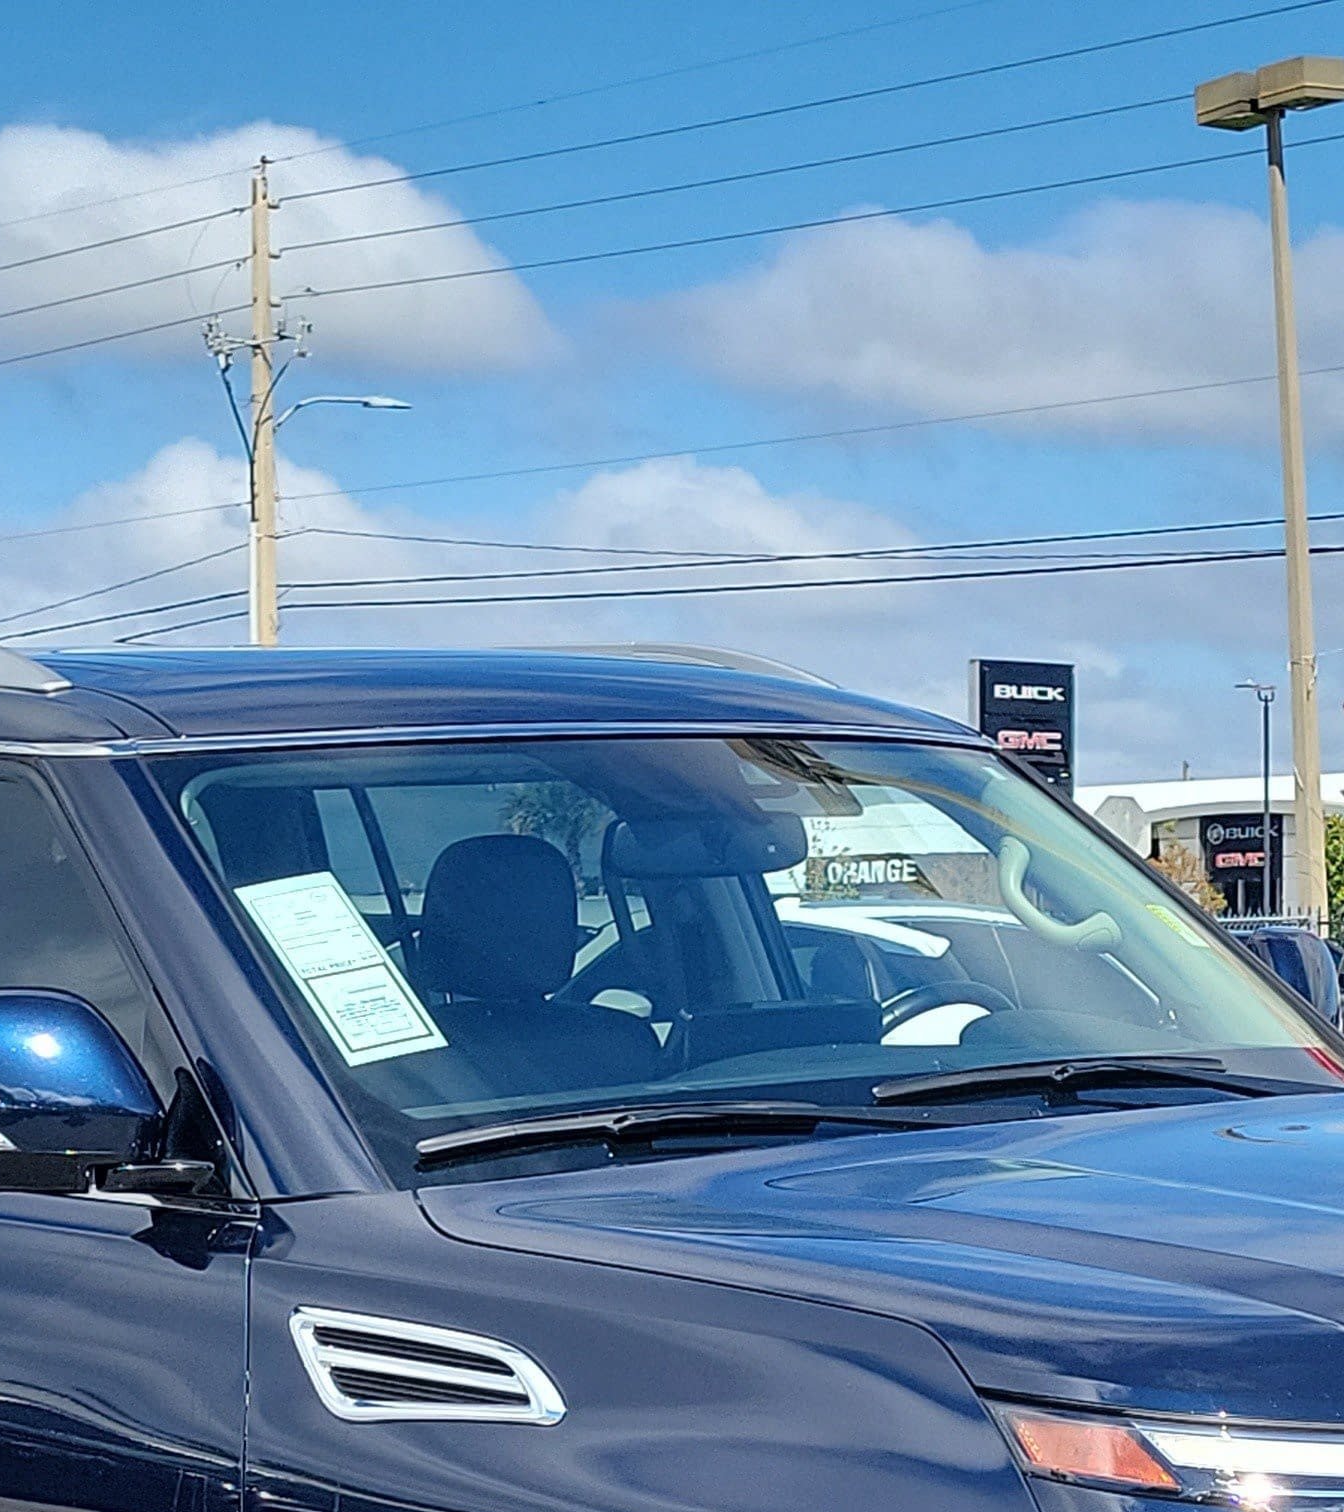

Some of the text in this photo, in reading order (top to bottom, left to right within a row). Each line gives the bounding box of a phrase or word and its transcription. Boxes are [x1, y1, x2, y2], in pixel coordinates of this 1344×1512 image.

[994, 684, 1065, 701] BUICK
[998, 730, 1062, 750] GMC
[1215, 852, 1264, 868] GMC
[826, 859, 918, 884] ORANGE
